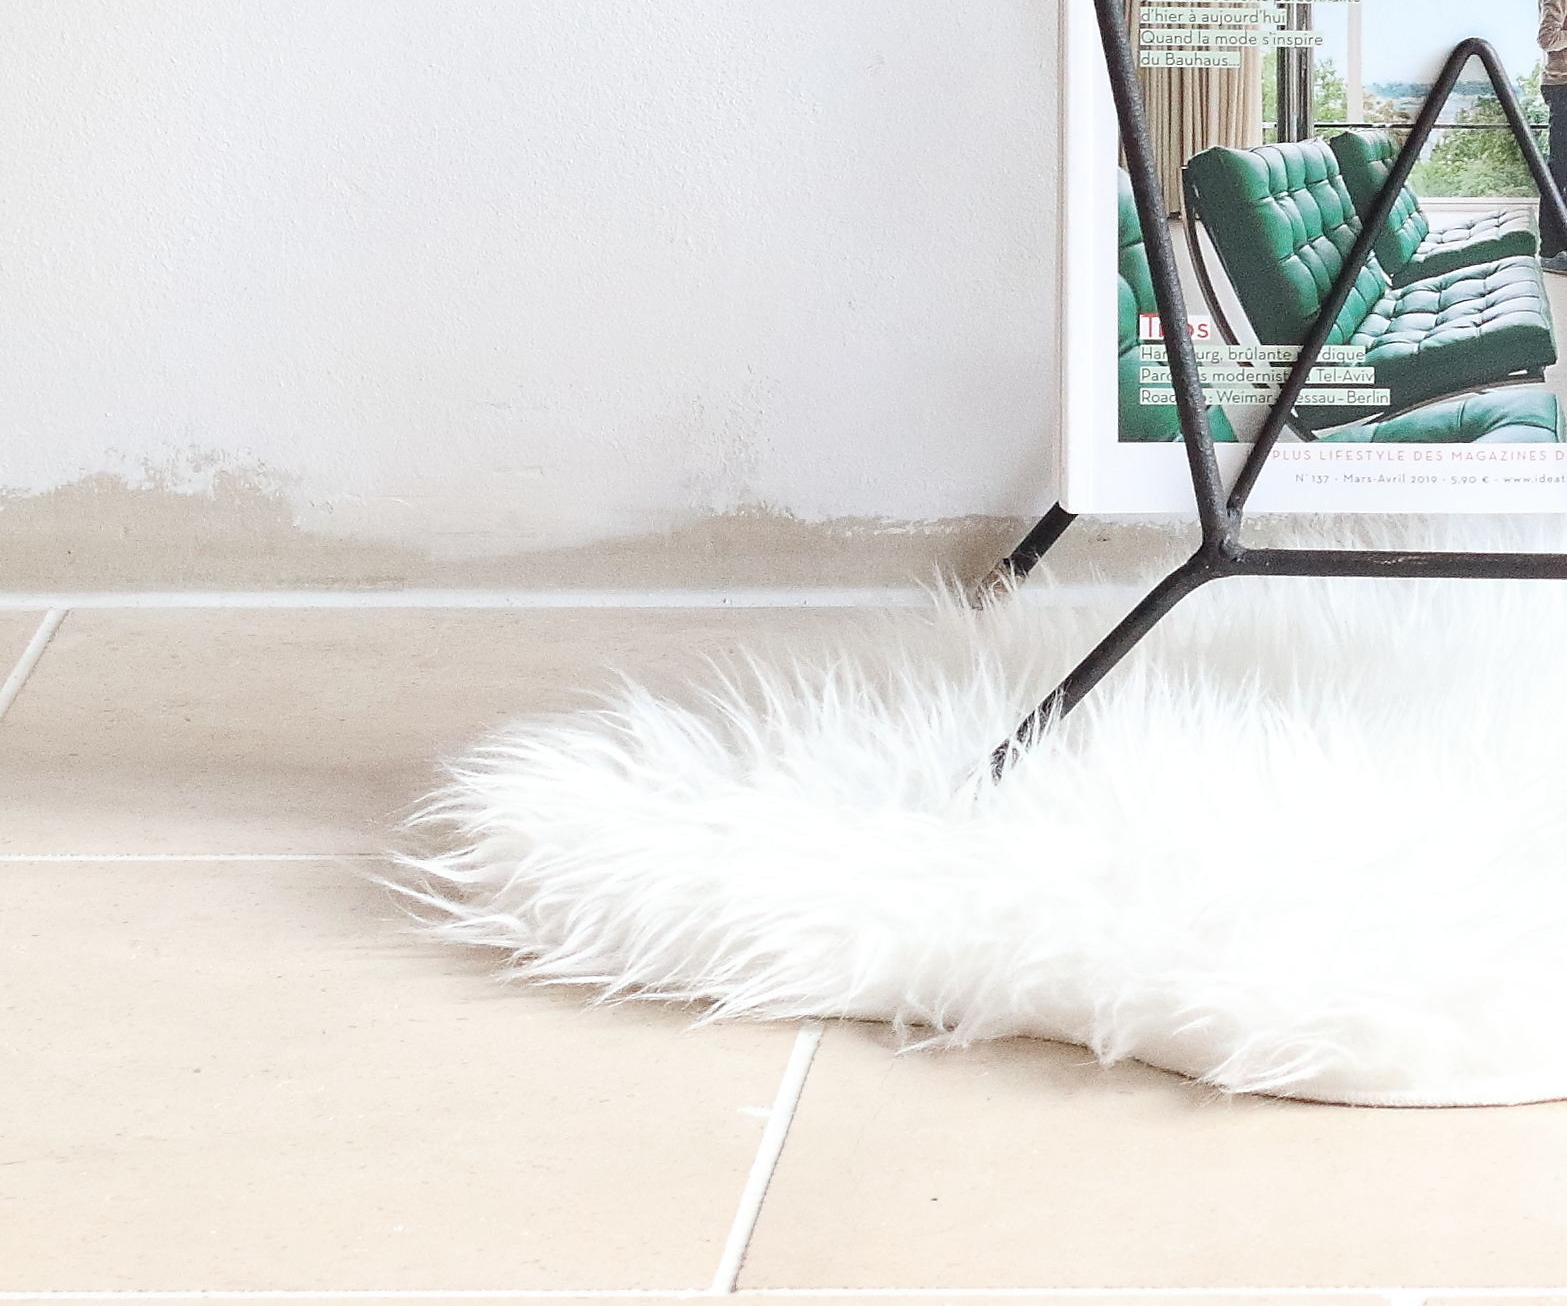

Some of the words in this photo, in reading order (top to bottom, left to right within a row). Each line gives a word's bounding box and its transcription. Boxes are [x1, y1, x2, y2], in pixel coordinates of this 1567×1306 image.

[1188, 10, 1197, 23] à
[1141, 30, 1193, 45] Quand
[1198, 30, 1210, 45] la
[1214, 31, 1257, 46] mode
[1141, 52, 1161, 66] du
[1228, 346, 1292, 361] brûlante
[1316, 368, 1375, 382] Tel-Aviv
[1272, 450, 1312, 461] PLUS
[1319, 450, 1405, 461] LIFESTYLE
[1413, 450, 1444, 461] DES
[1451, 450, 1547, 461] MAGAZINES
[1343, 473, 1406, 483] Mars-Avril
[1410, 475, 1438, 484] 2019
